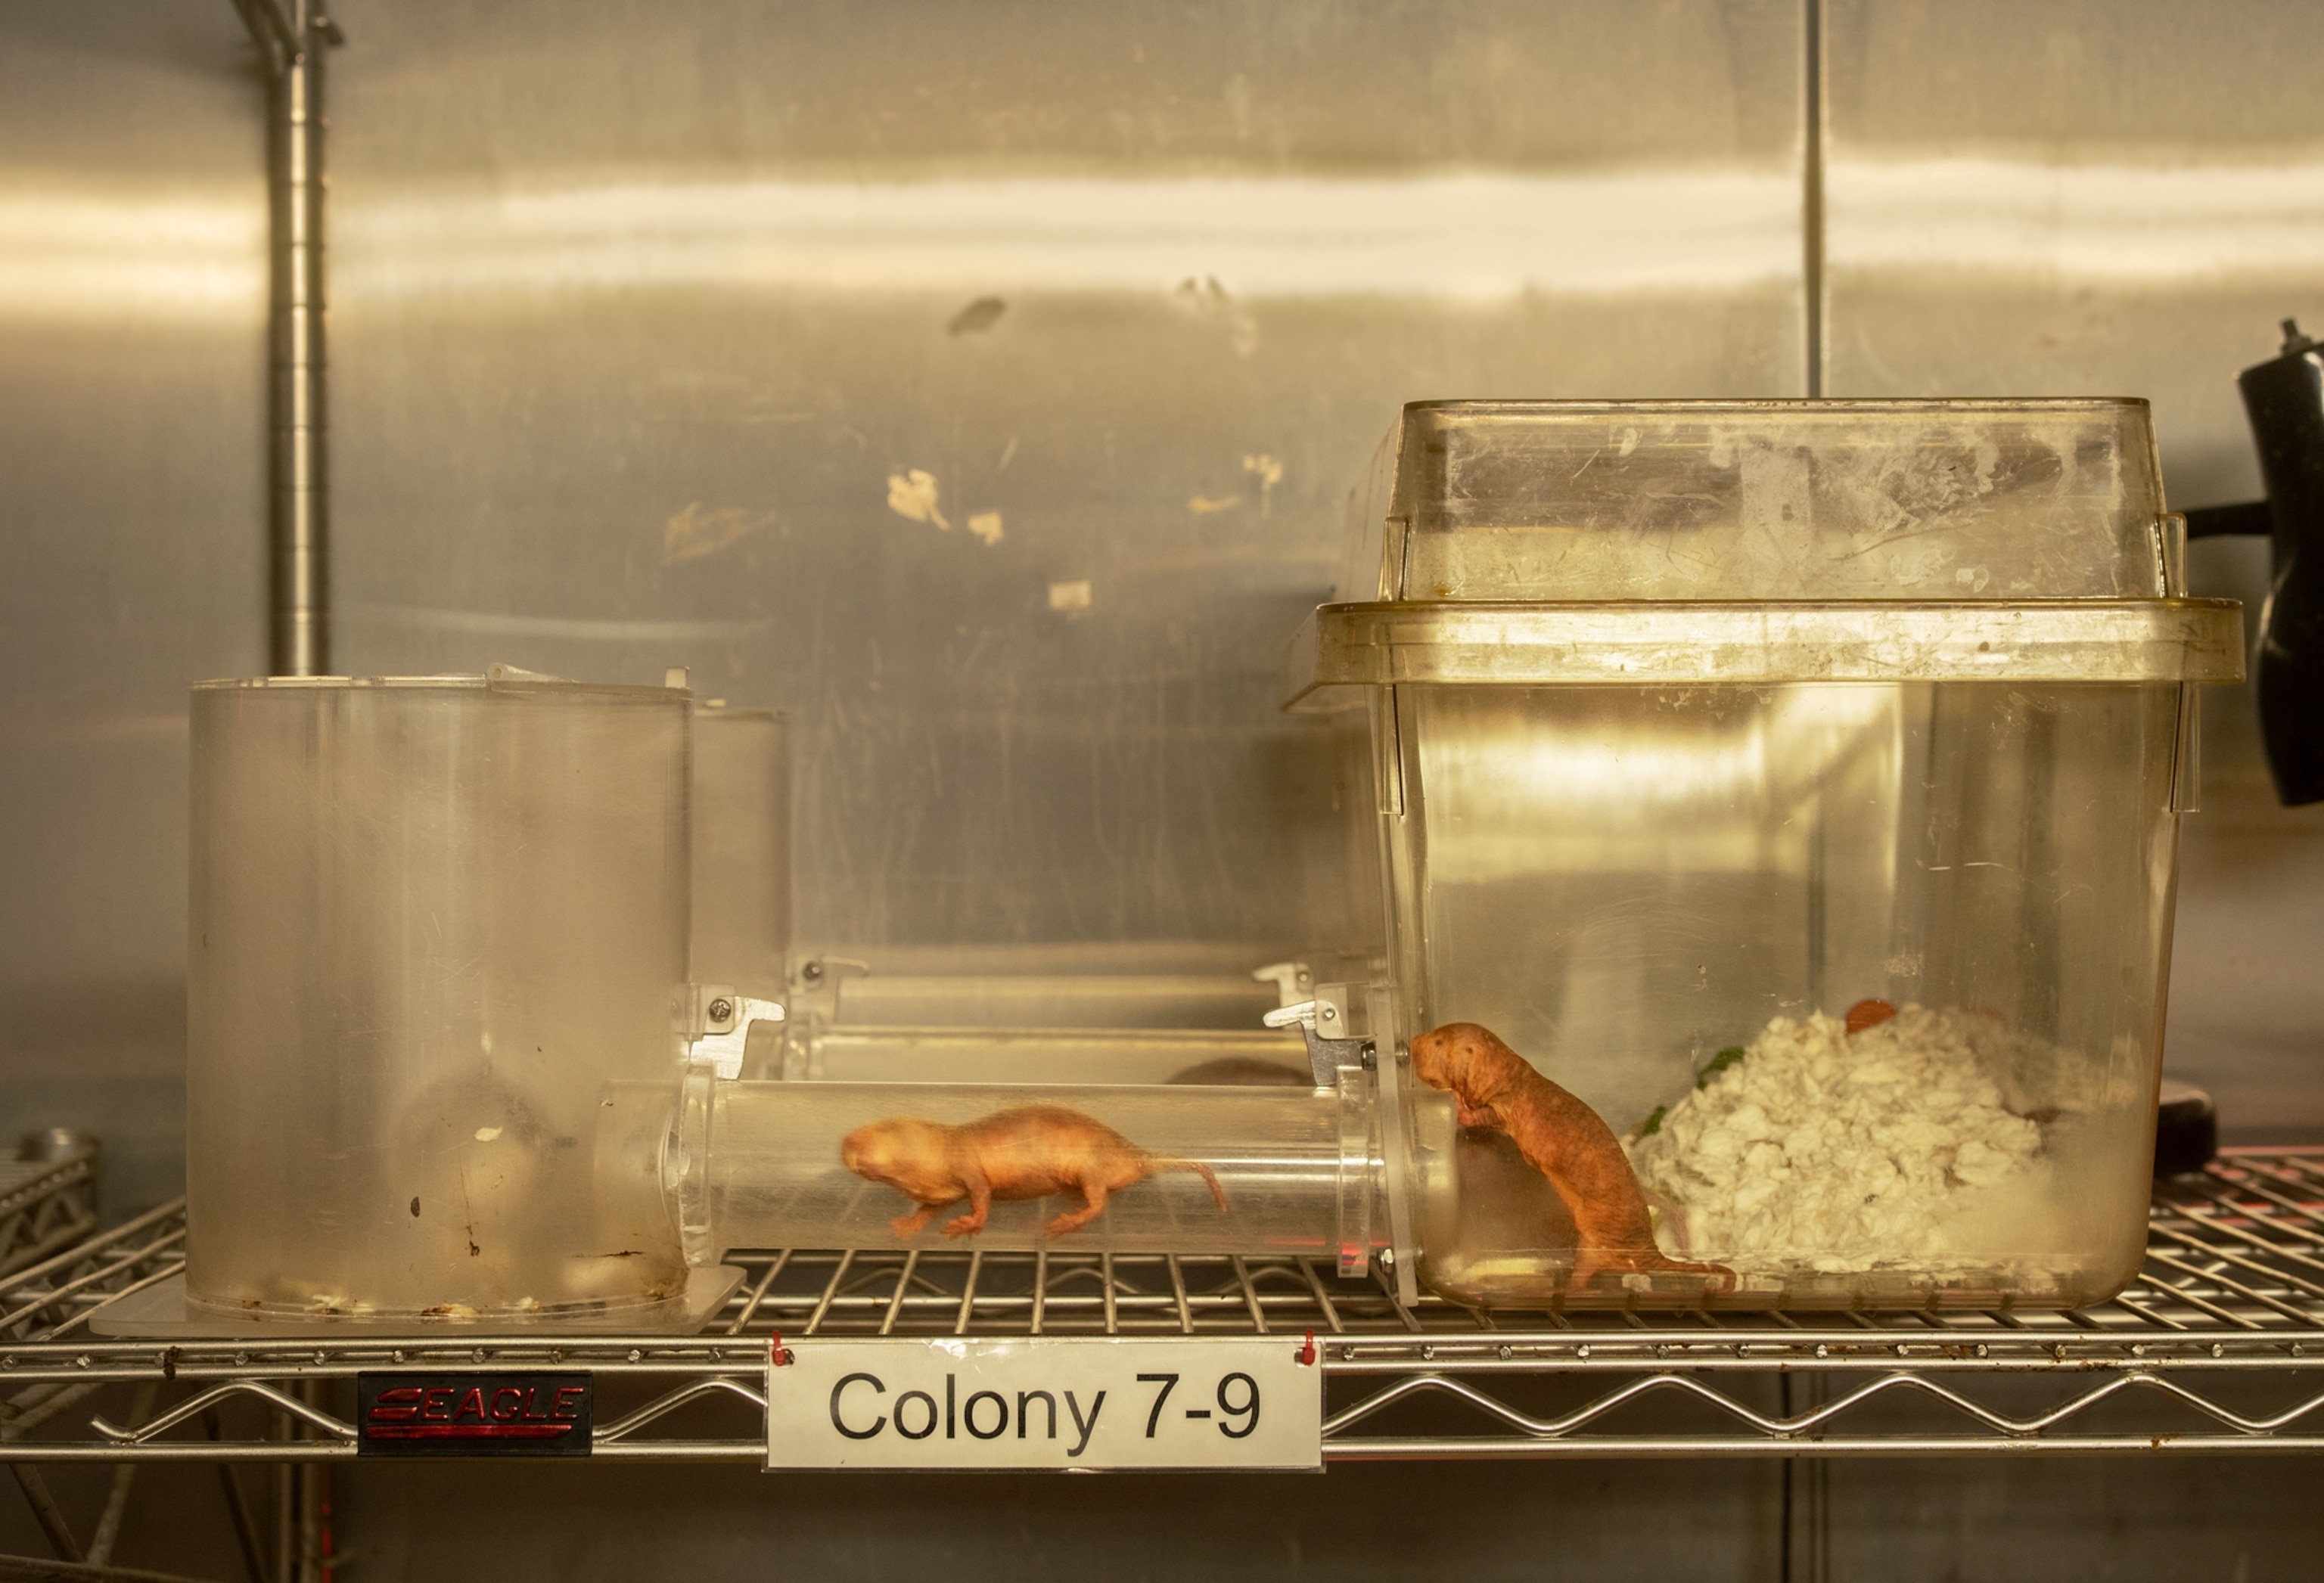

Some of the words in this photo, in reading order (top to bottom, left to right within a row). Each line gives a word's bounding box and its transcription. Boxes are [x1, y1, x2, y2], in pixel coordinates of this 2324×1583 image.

[420, 1387, 584, 1421] EAGLE
[830, 1373, 1107, 1457] Colony
[1136, 1373, 1260, 1439] 7-9
